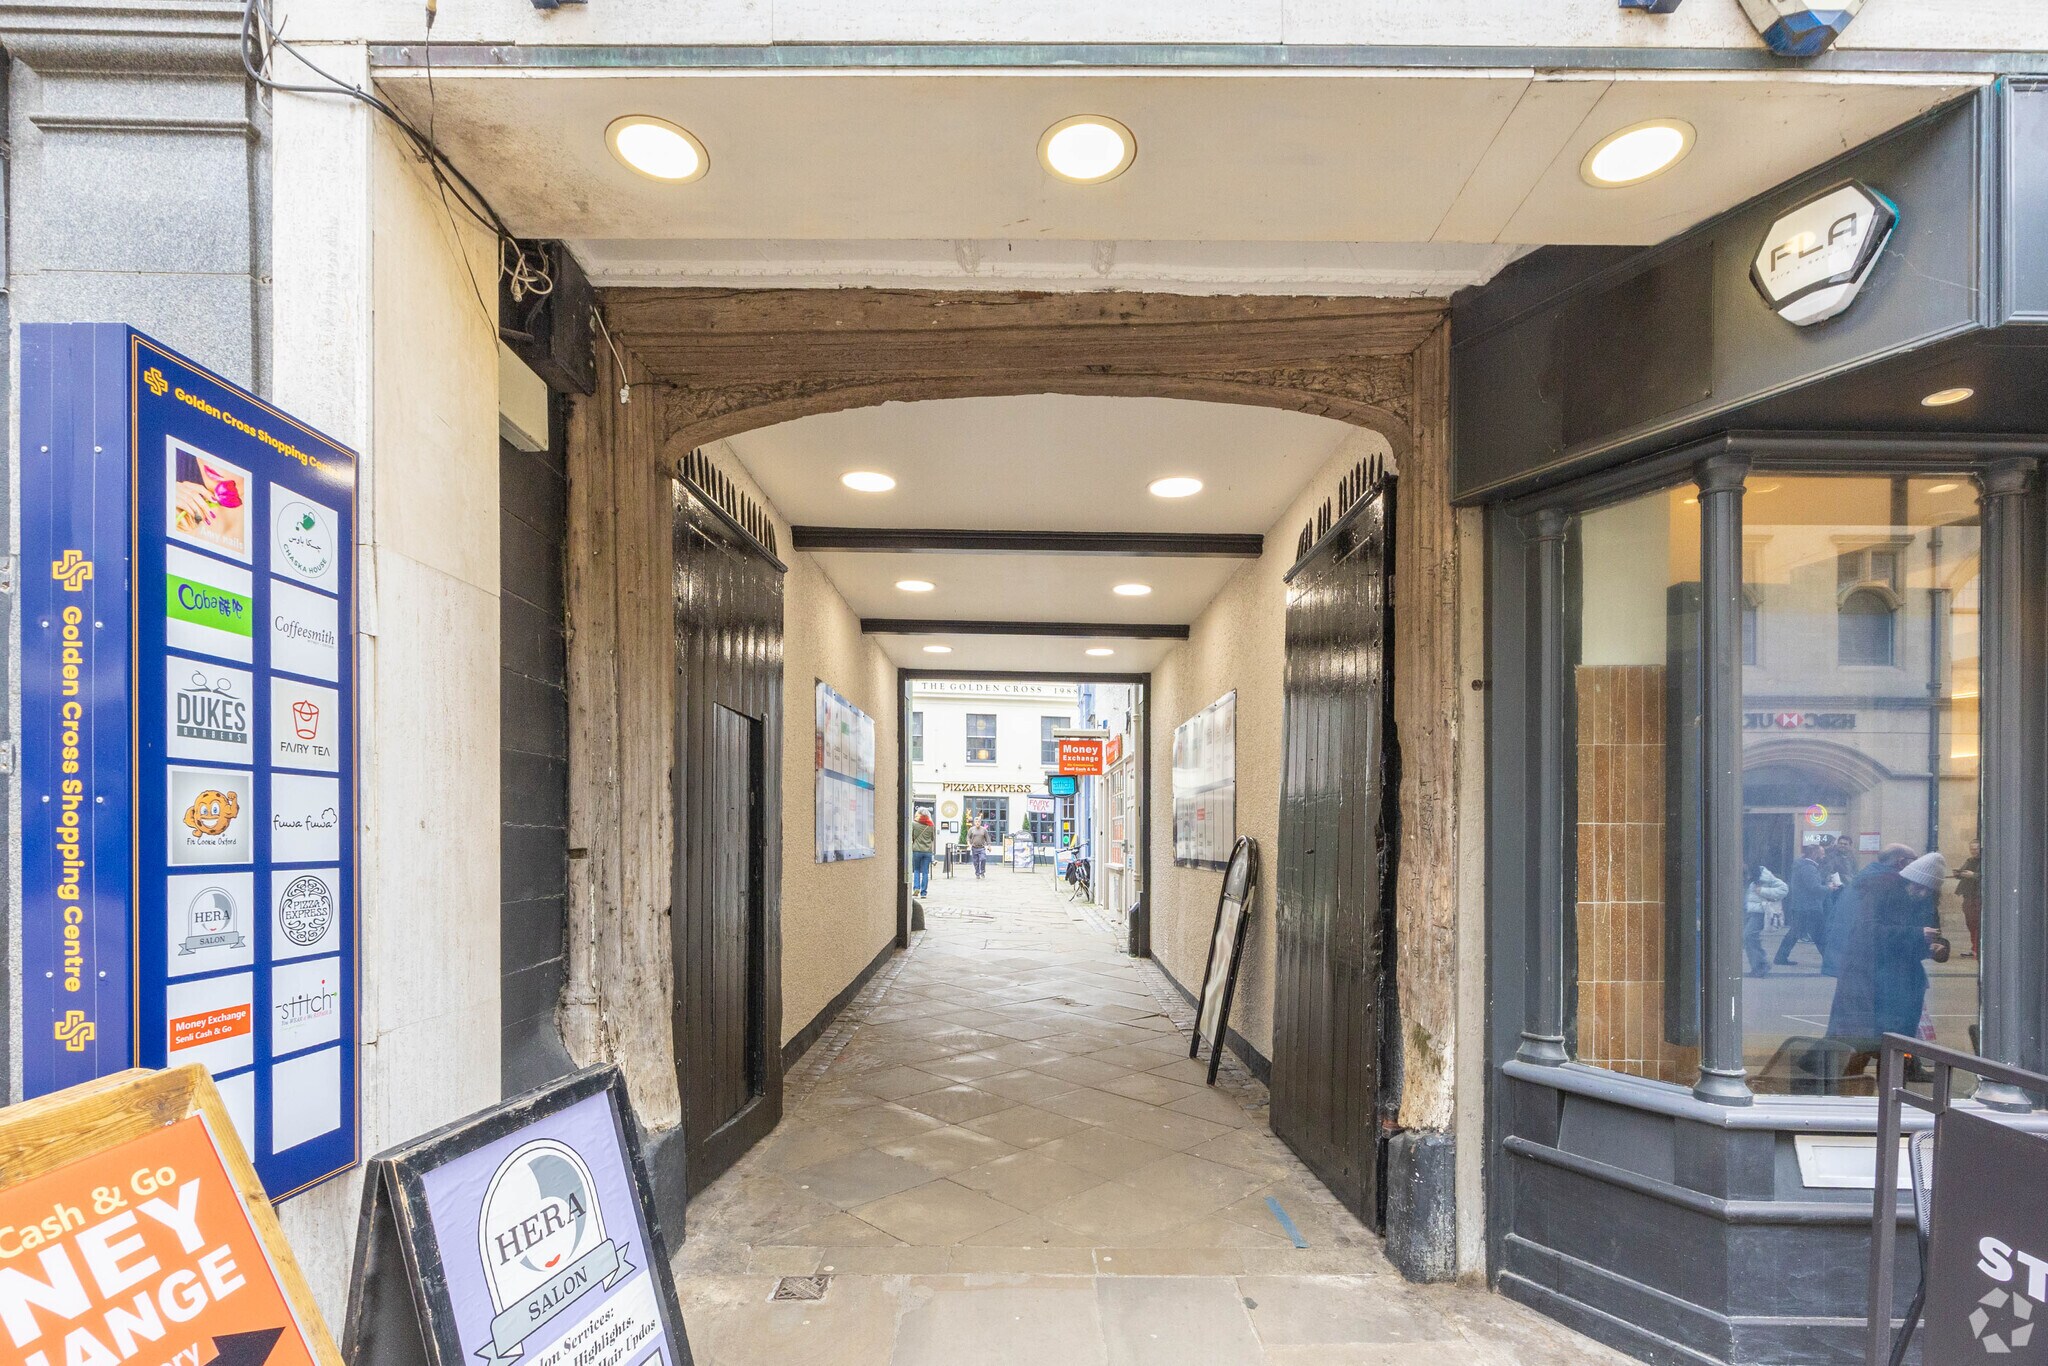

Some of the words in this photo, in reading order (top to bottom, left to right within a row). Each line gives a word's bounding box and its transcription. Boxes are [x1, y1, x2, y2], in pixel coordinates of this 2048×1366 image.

[1770, 212, 1857, 273] FLA
[174, 387, 221, 420] Golden
[222, 411, 257, 438] Cross
[257, 429, 308, 467] Shopping
[308, 455, 342, 481] Cent
[282, 543, 308, 573] CHASKA
[309, 557, 328, 574] HOUSE
[177, 583, 217, 611] Coba
[274, 615, 335, 645] Coffeesmith
[62, 605, 83, 696] Golden
[921, 682, 945, 690] THE
[950, 683, 1000, 692] GOLDEN
[1004, 685, 1042, 693] CROSS
[177, 692, 246, 732] DUKES
[62, 701, 83, 774] Cross
[183, 727, 242, 743] BARBERS
[280, 742, 309, 755] FAIRY
[313, 745, 330, 756] TEA
[1062, 744, 1098, 756] Money
[1062, 754, 1099, 763] Exchange
[56, 779, 85, 900] Shopping
[195, 910, 231, 923] HERA
[285, 908, 328, 921] EXPRESS
[293, 899, 321, 910] PIZZA
[63, 905, 84, 992] Centre
[199, 936, 226, 946] SALON
[281, 986, 332, 1020] stitch
[175, 1018, 206, 1032] Money
[207, 1010, 247, 1026] Exchange
[175, 1033, 194, 1045] Senli
[195, 1029, 212, 1040] Cash
[0, 1203, 85, 1258] Cash
[91, 1186, 128, 1215] &
[130, 1166, 177, 1196] Go
[494, 1192, 587, 1267] HERA
[24, 1243, 247, 1366] ANGE
[527, 1266, 589, 1322] SALON
[563, 1307, 615, 1356] Services:
[573, 1316, 635, 1366] Highlights.
[626, 1318, 657, 1352] Updos
